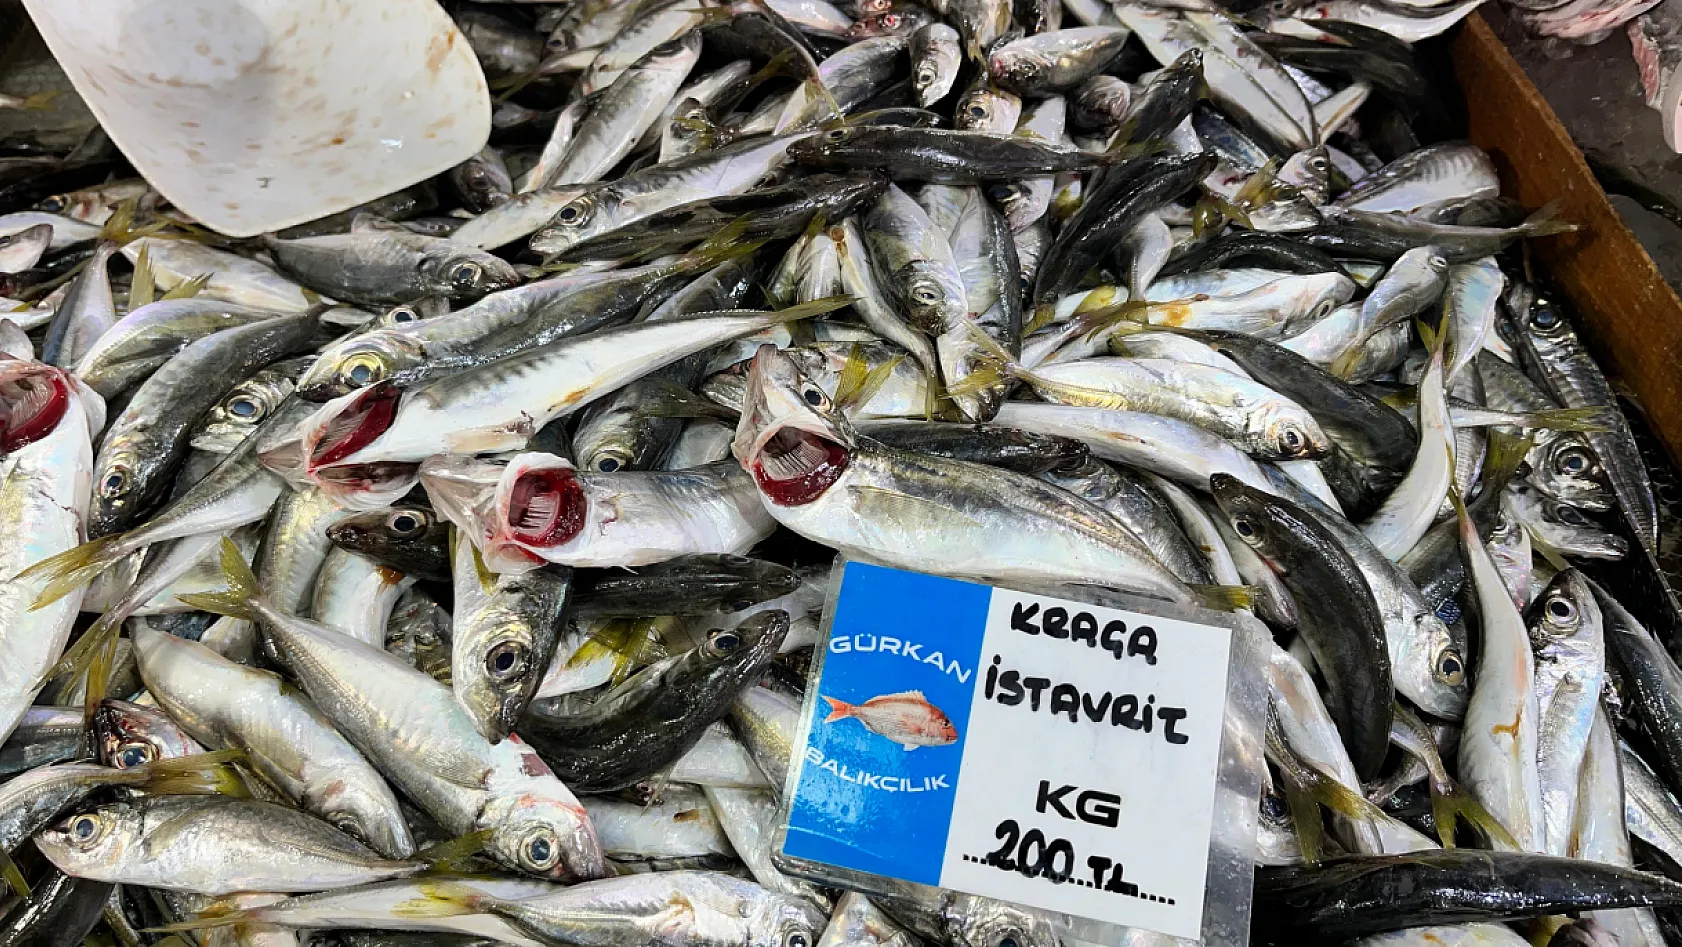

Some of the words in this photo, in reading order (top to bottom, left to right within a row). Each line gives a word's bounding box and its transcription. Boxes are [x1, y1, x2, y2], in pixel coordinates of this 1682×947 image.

[828, 632, 973, 685] GÜRKAN
[804, 746, 951, 793] BALIKÇILIK
[1035, 779, 1122, 828] KG
[985, 818, 1076, 884] 200
[1086, 854, 1139, 898] TL
